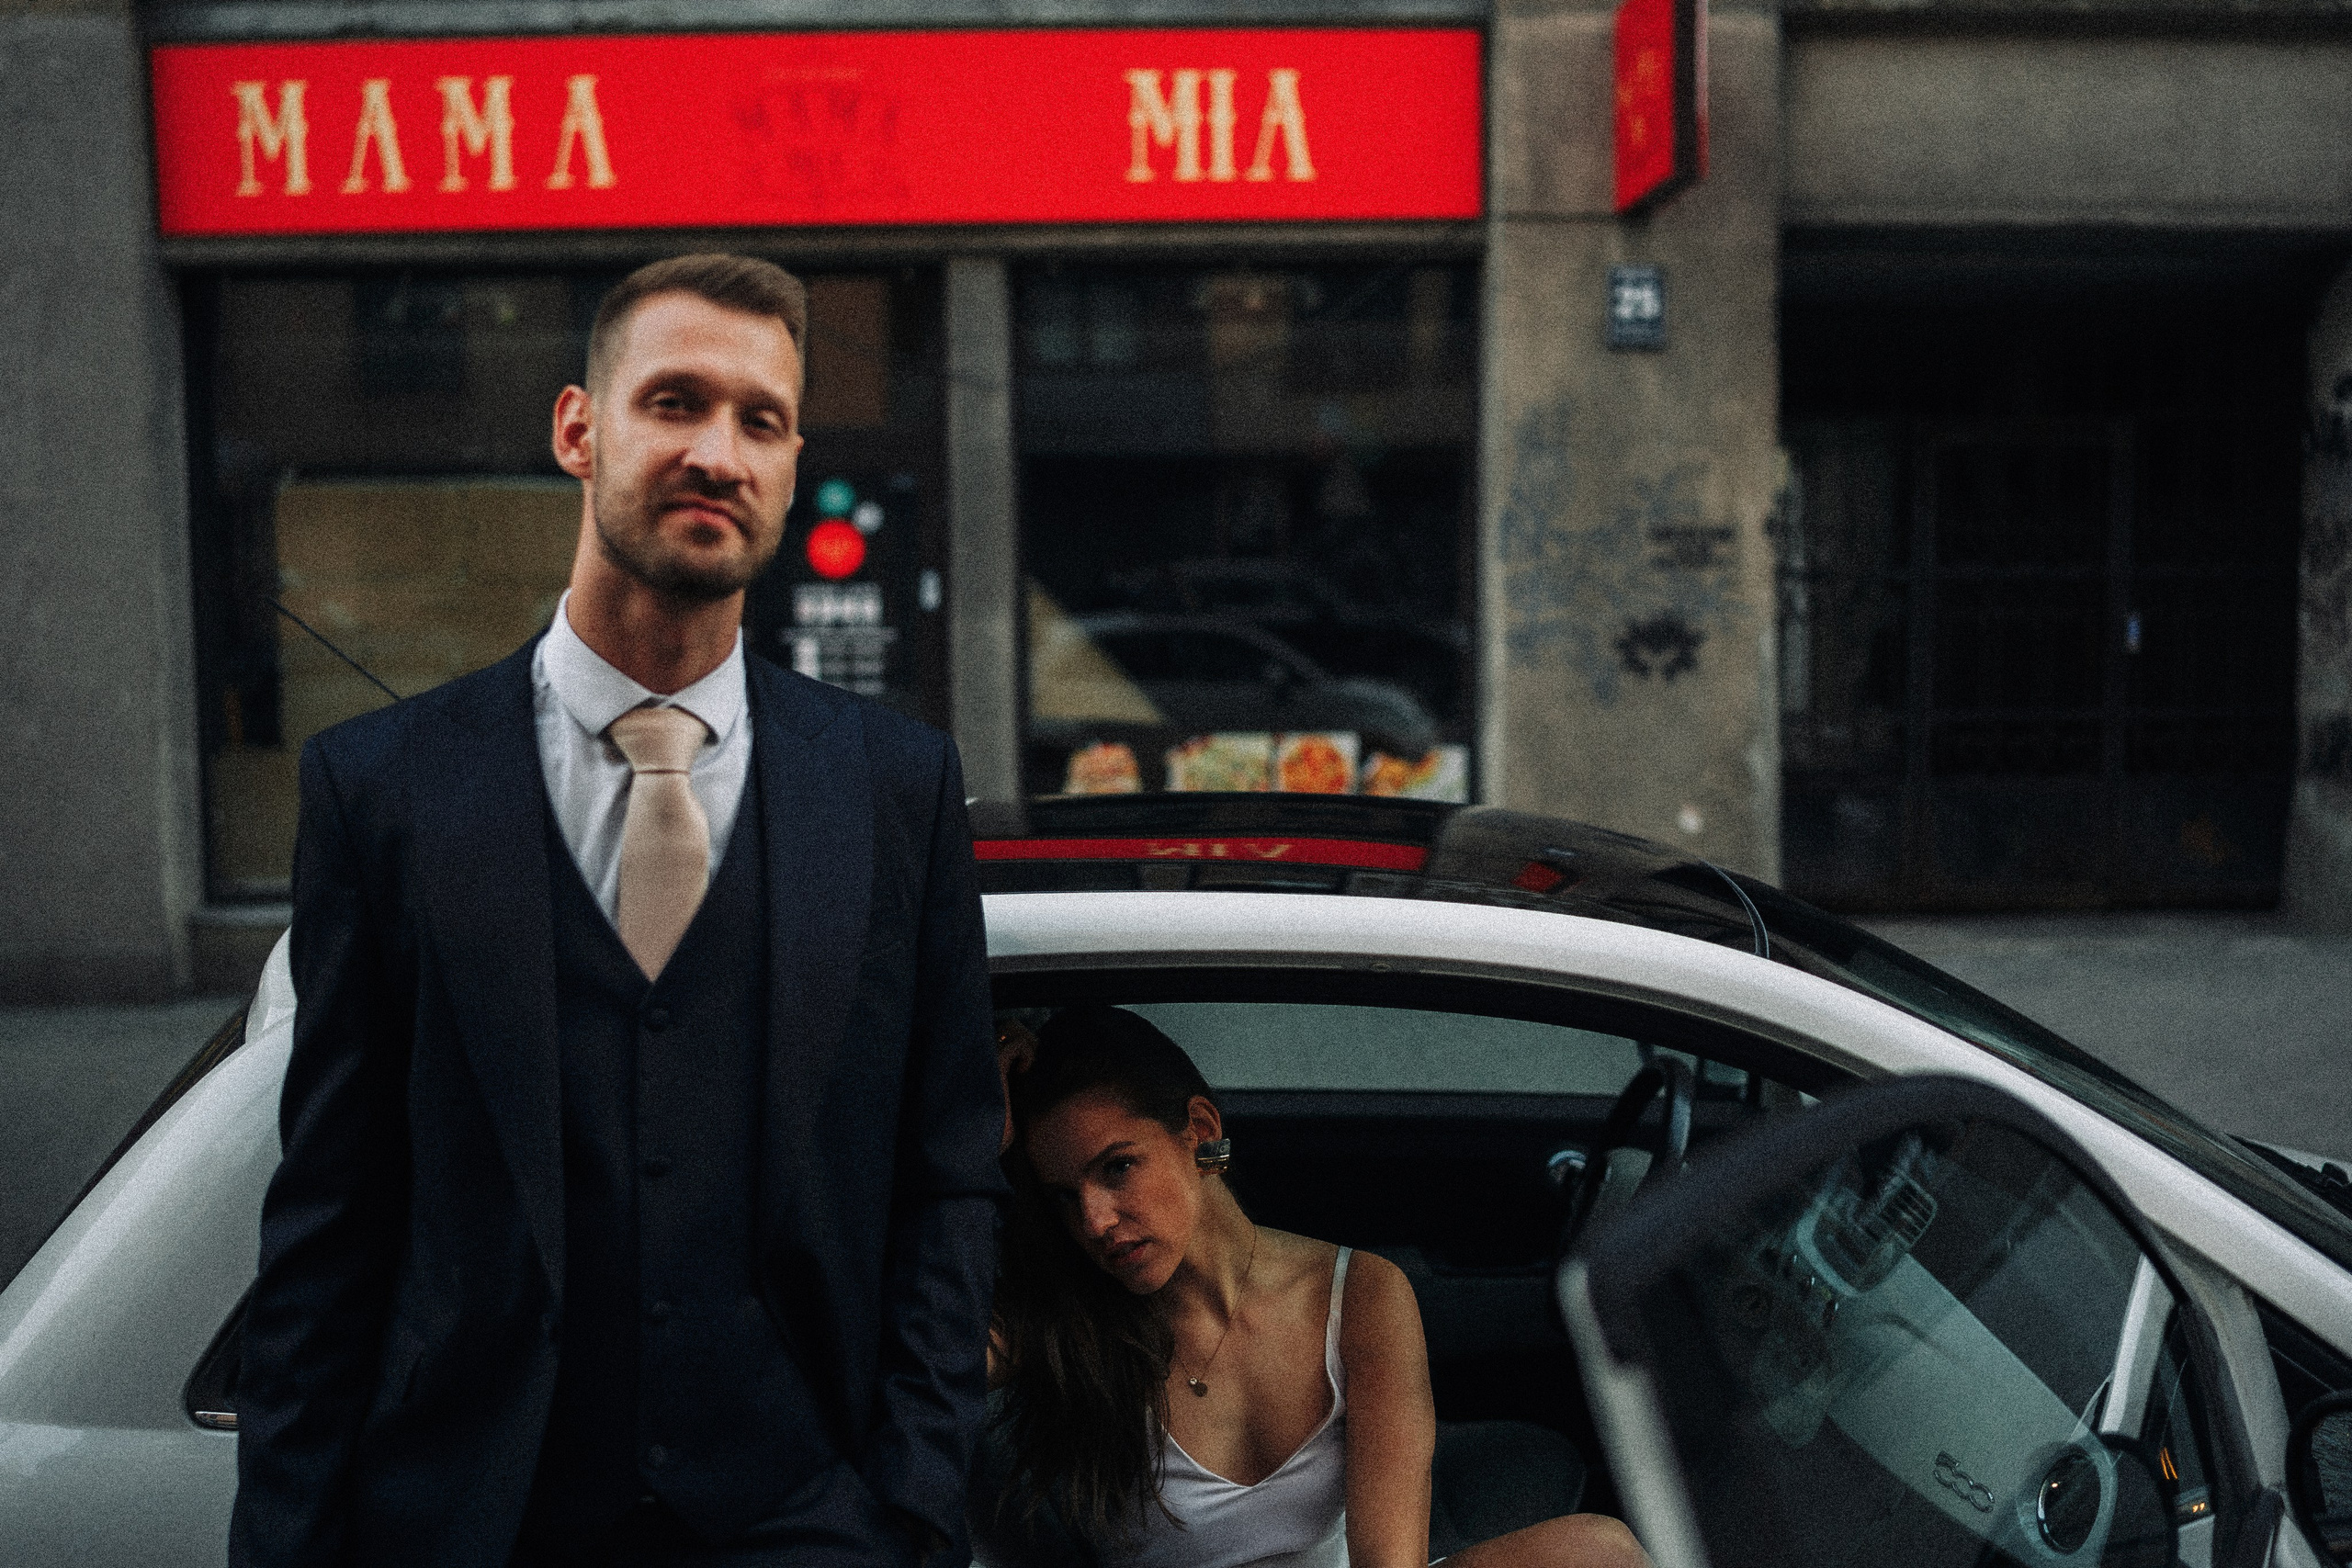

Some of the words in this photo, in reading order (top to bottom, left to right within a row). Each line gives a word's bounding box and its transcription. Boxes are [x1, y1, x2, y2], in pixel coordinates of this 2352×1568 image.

[232, 73, 617, 197] MAMA
[1124, 67, 1317, 182] MIA
[1932, 1450, 1996, 1514] 500
